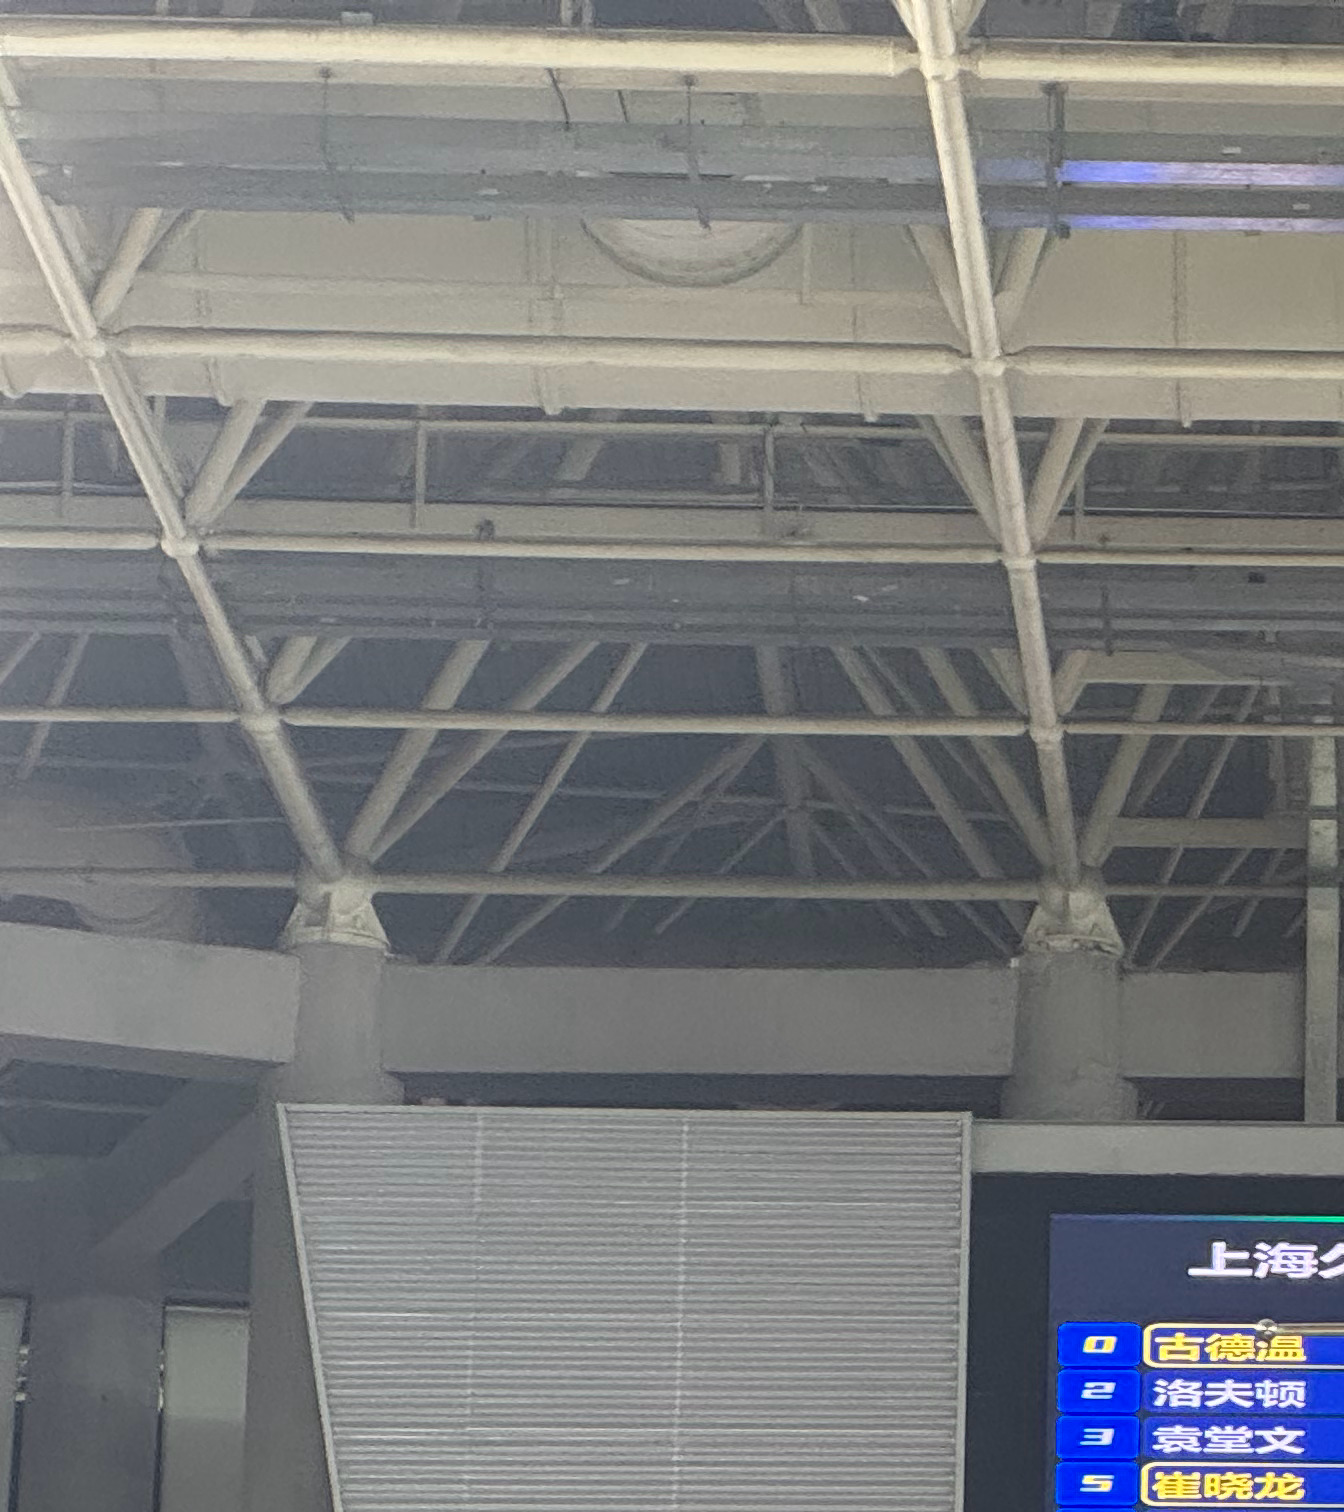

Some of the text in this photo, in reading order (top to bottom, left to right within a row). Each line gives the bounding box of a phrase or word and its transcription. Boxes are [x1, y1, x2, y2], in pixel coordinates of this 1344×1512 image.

[1083, 1335, 1117, 1354] 0
[1152, 1334, 1307, 1364] 古德温
[1081, 1381, 1116, 1399] 2
[1152, 1378, 1307, 1409] 洛夫顿
[1081, 1428, 1115, 1446] 3
[1151, 1424, 1306, 1455] 袁堂文
[1080, 1474, 1114, 1493] 5
[1149, 1470, 1306, 1503] 崔晓龙
